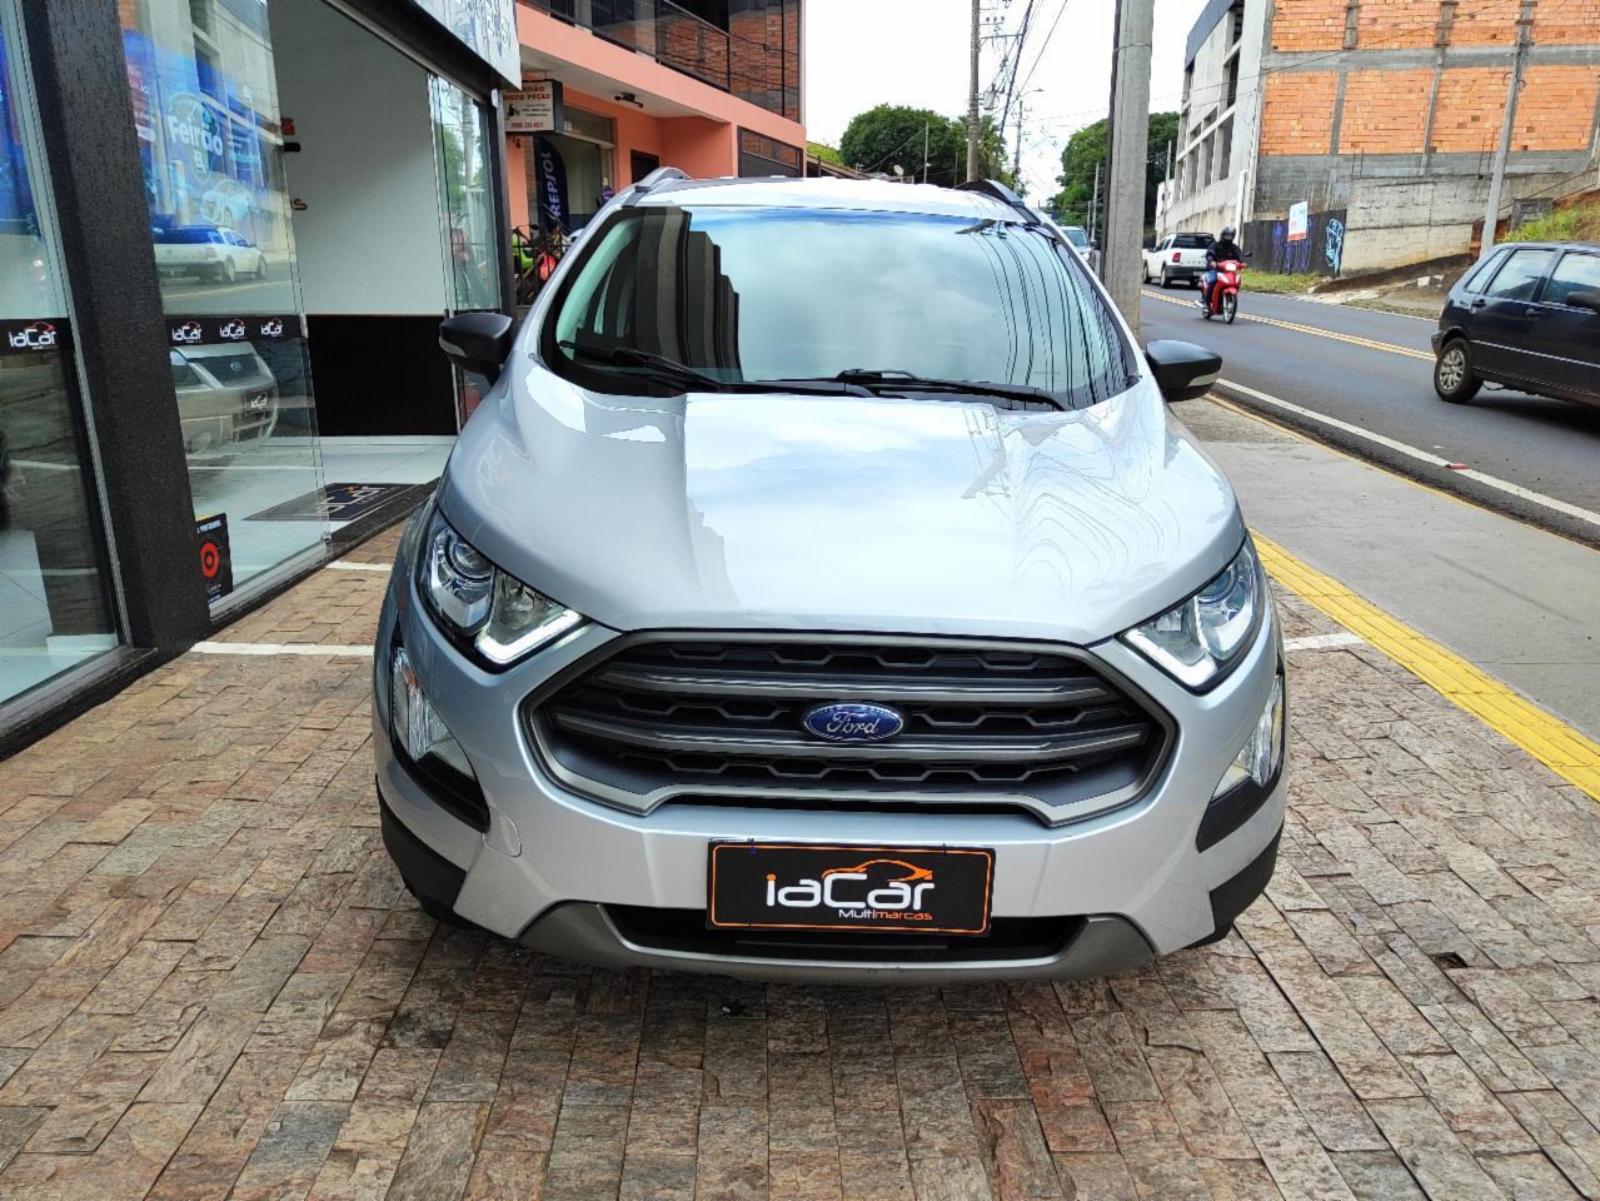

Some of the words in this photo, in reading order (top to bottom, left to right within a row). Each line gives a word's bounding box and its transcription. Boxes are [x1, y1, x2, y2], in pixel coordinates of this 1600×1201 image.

[541, 151, 561, 217] REPSOL
[826, 711, 881, 734] Ford
[766, 872, 935, 911] iaCar
[838, 909, 933, 921] Multimarcas
